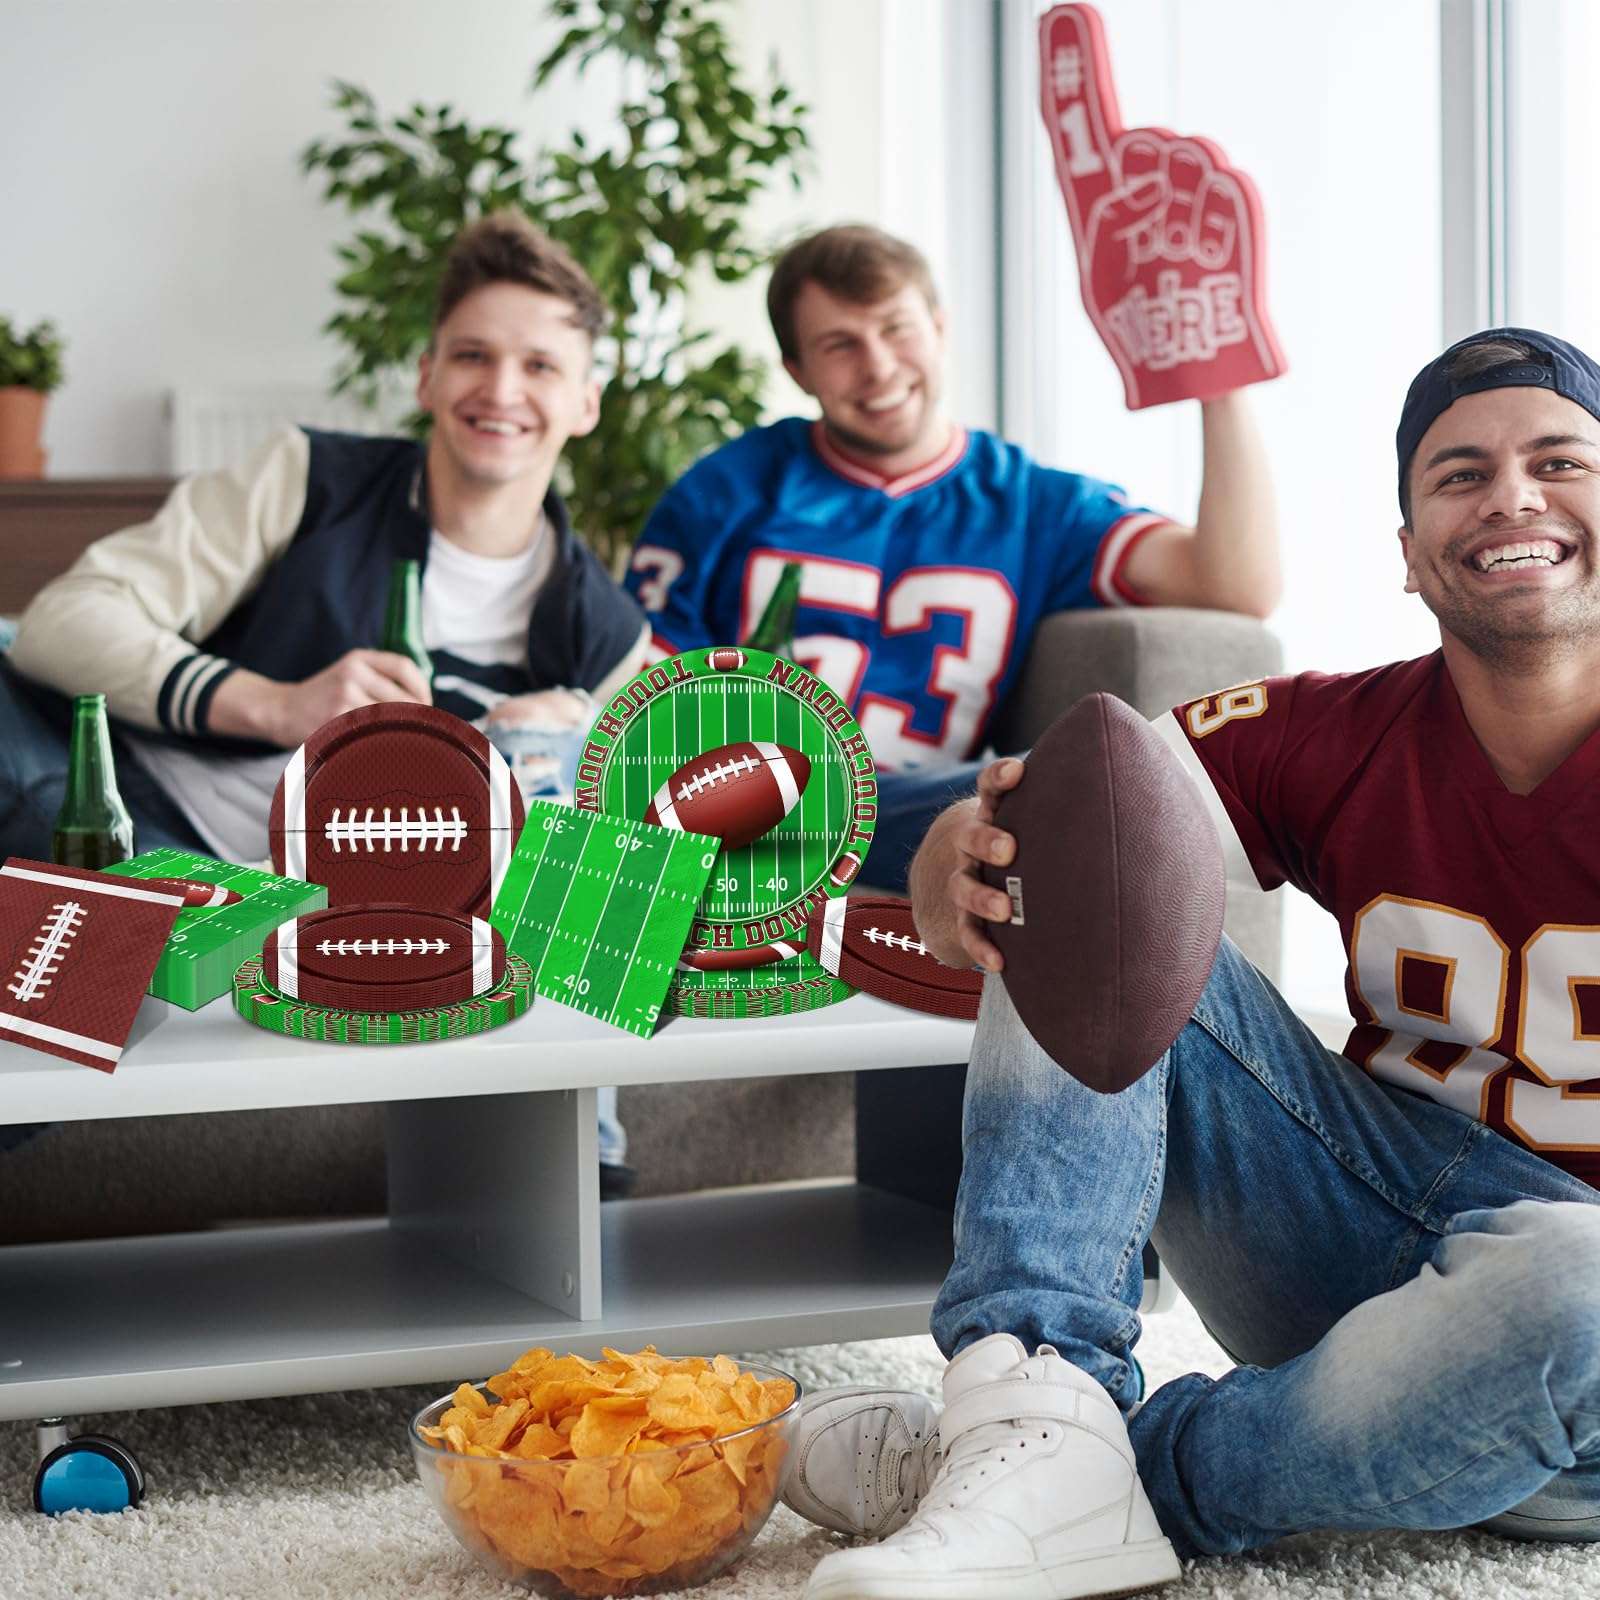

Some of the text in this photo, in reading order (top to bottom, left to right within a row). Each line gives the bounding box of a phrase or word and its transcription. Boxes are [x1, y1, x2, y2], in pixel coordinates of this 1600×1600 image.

[575, 657, 694, 814] TOUCH DOW
[738, 547, 1018, 772] 53
[766, 657, 878, 845] TOUCH DOWN
[742, 884, 832, 947] DOWN
